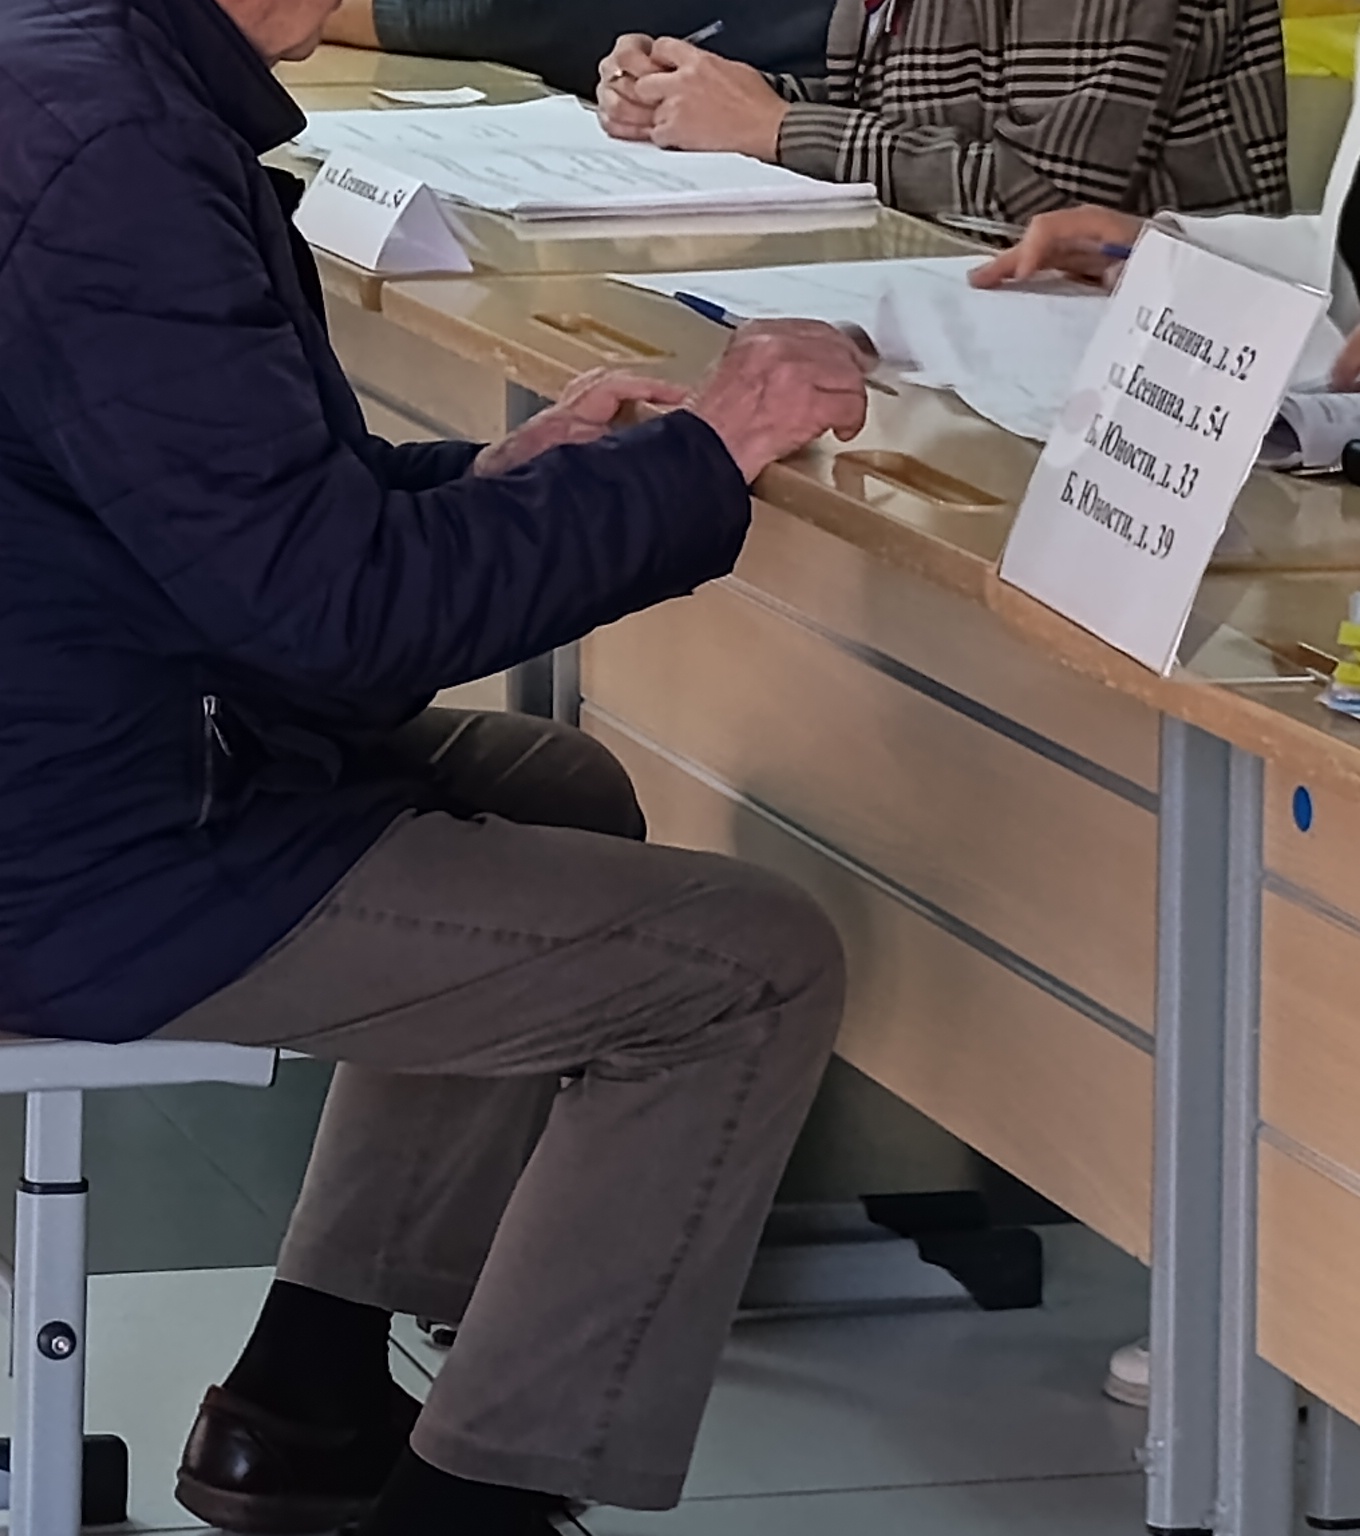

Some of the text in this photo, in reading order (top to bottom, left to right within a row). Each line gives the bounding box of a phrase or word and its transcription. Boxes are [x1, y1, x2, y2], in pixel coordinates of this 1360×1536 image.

[1230, 346, 1257, 381] 52
[1202, 405, 1230, 442] 54
[1172, 463, 1199, 498] 33
[1060, 470, 1078, 506] Б.
[1150, 524, 1175, 559] 39
